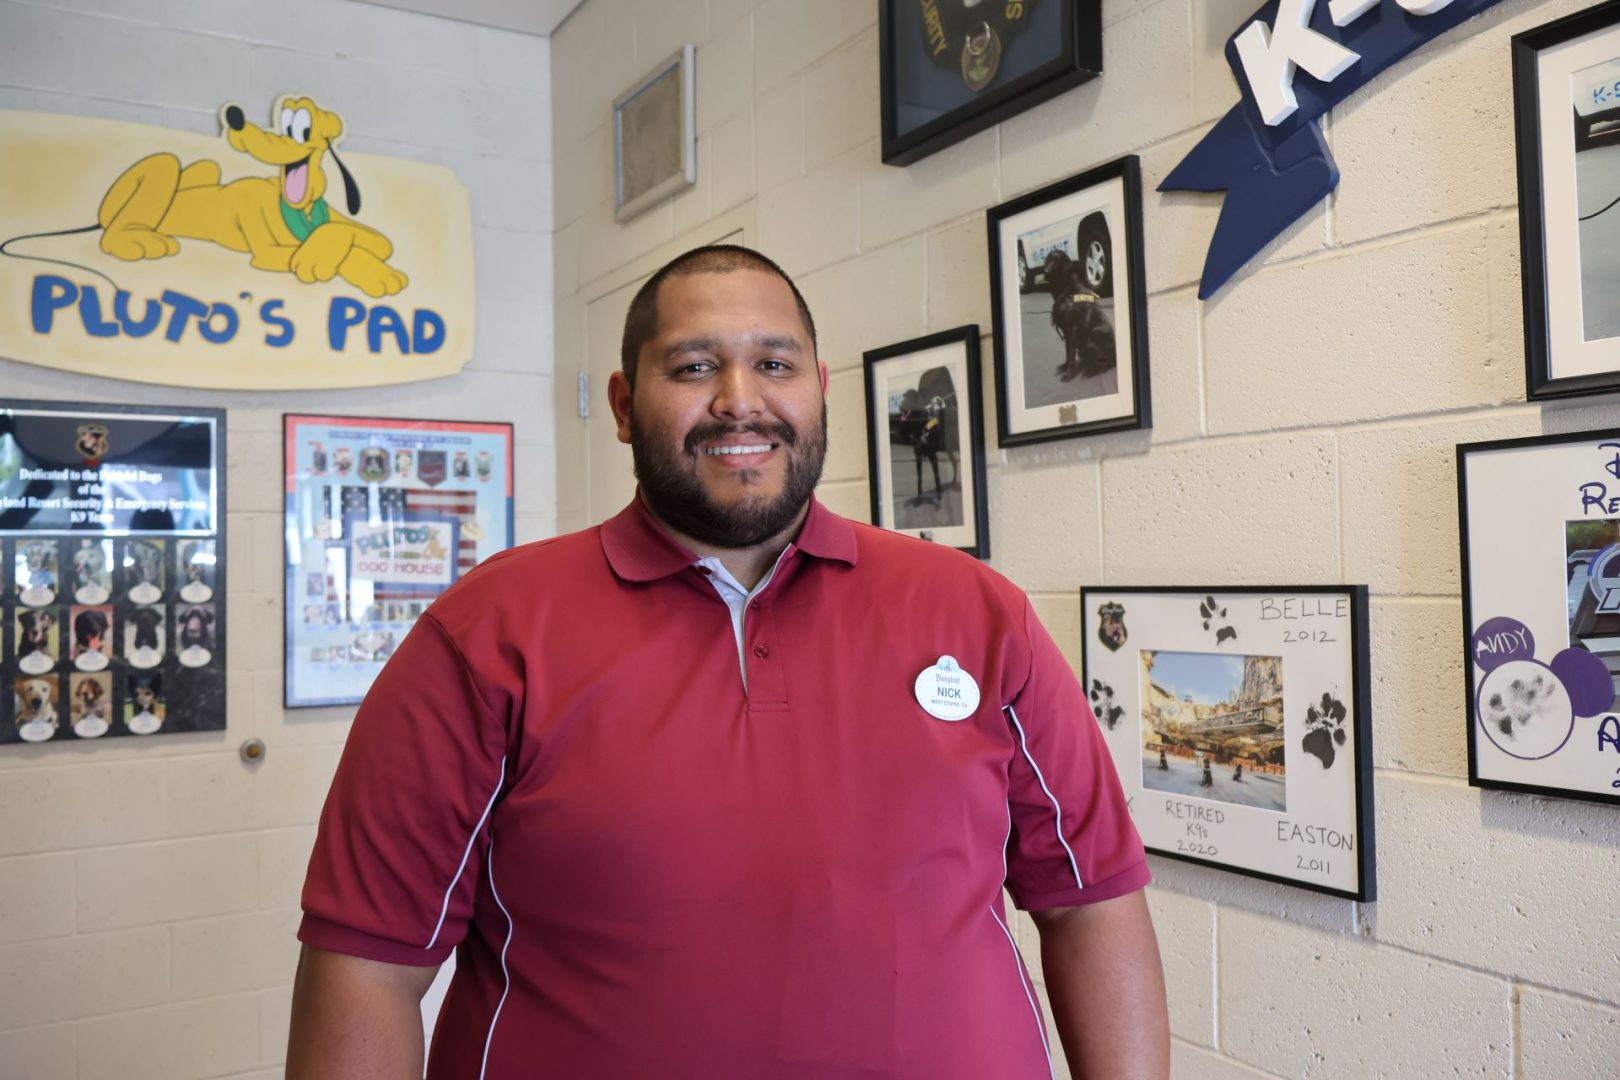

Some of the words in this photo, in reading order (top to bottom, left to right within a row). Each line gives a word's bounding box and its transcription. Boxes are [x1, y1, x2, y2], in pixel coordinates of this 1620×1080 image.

[31, 274, 295, 348] PLUTO'S
[328, 297, 446, 355] PAD
[70, 469, 81, 480] to
[82, 469, 98, 481] the
[0, 496, 26, 509] land
[359, 561, 388, 573] DOG
[394, 563, 444, 576] HOUSE
[1259, 598, 1348, 620] BELLE
[1283, 630, 1337, 643] 2012
[1475, 627, 1528, 659] ANDY
[937, 686, 961, 699] NICK
[1165, 800, 1225, 824] RETIRED
[1278, 820, 1353, 851] EASTON
[1177, 839, 1218, 856] 2020
[1296, 855, 1330, 875] 2011
